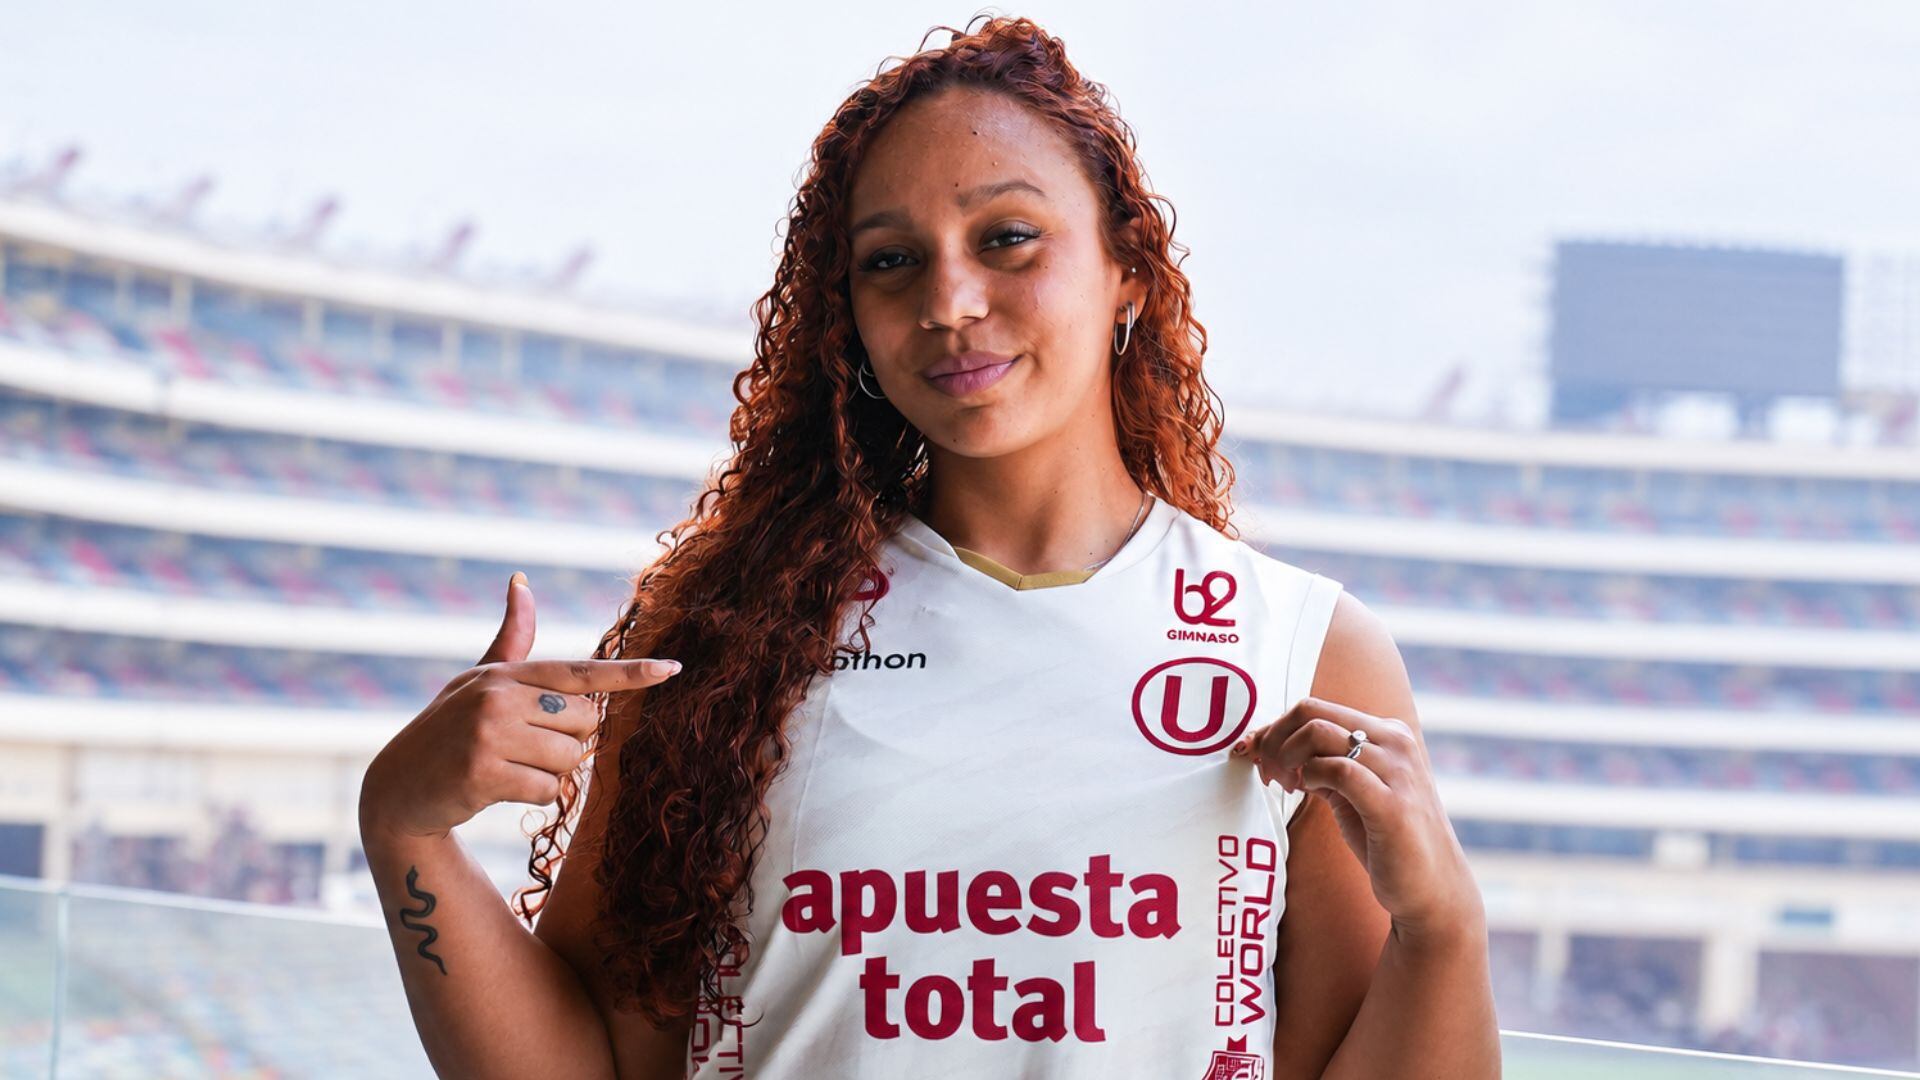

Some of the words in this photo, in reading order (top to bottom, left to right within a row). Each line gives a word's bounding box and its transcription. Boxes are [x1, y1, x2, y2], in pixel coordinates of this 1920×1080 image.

[1173, 568, 1237, 627] b2
[832, 650, 926, 670] athon
[1167, 629, 1239, 644] GIMNASO
[1160, 675, 1229, 743] U
[781, 854, 1182, 956] apuesta
[1215, 835, 1239, 1026] COLECTIVO
[1240, 837, 1276, 1025] WORLD
[859, 956, 1106, 1043] total
